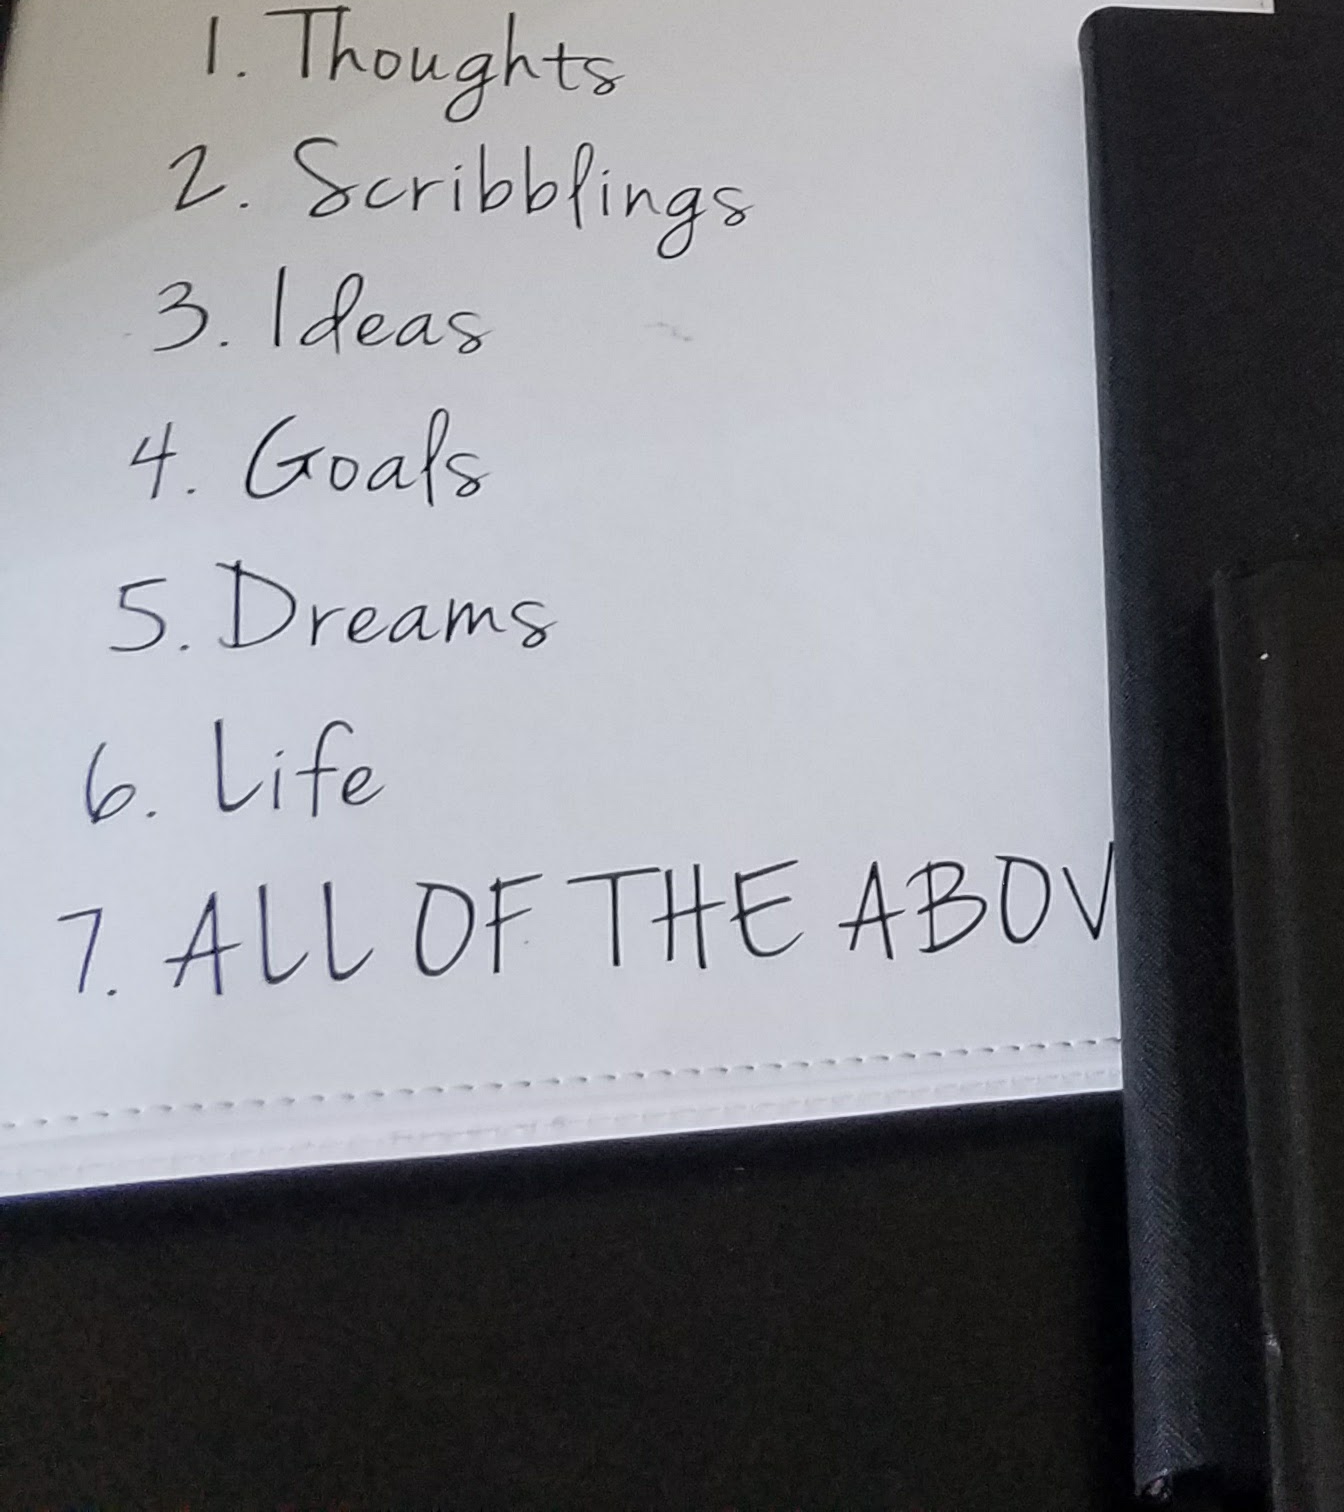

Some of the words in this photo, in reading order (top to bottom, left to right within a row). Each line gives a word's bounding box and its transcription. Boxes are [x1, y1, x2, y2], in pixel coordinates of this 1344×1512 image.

[263, 4, 624, 124] Thoughts
[293, 136, 753, 260] Scribblings
[273, 265, 485, 355] Ideas
[244, 407, 489, 507] Goals
[215, 559, 557, 649] Dreams
[214, 718, 385, 818] Life
[164, 881, 374, 996] ALL
[415, 873, 543, 977] OF
[566, 859, 804, 970] THE
[839, 842, 1114, 961] ABOV
